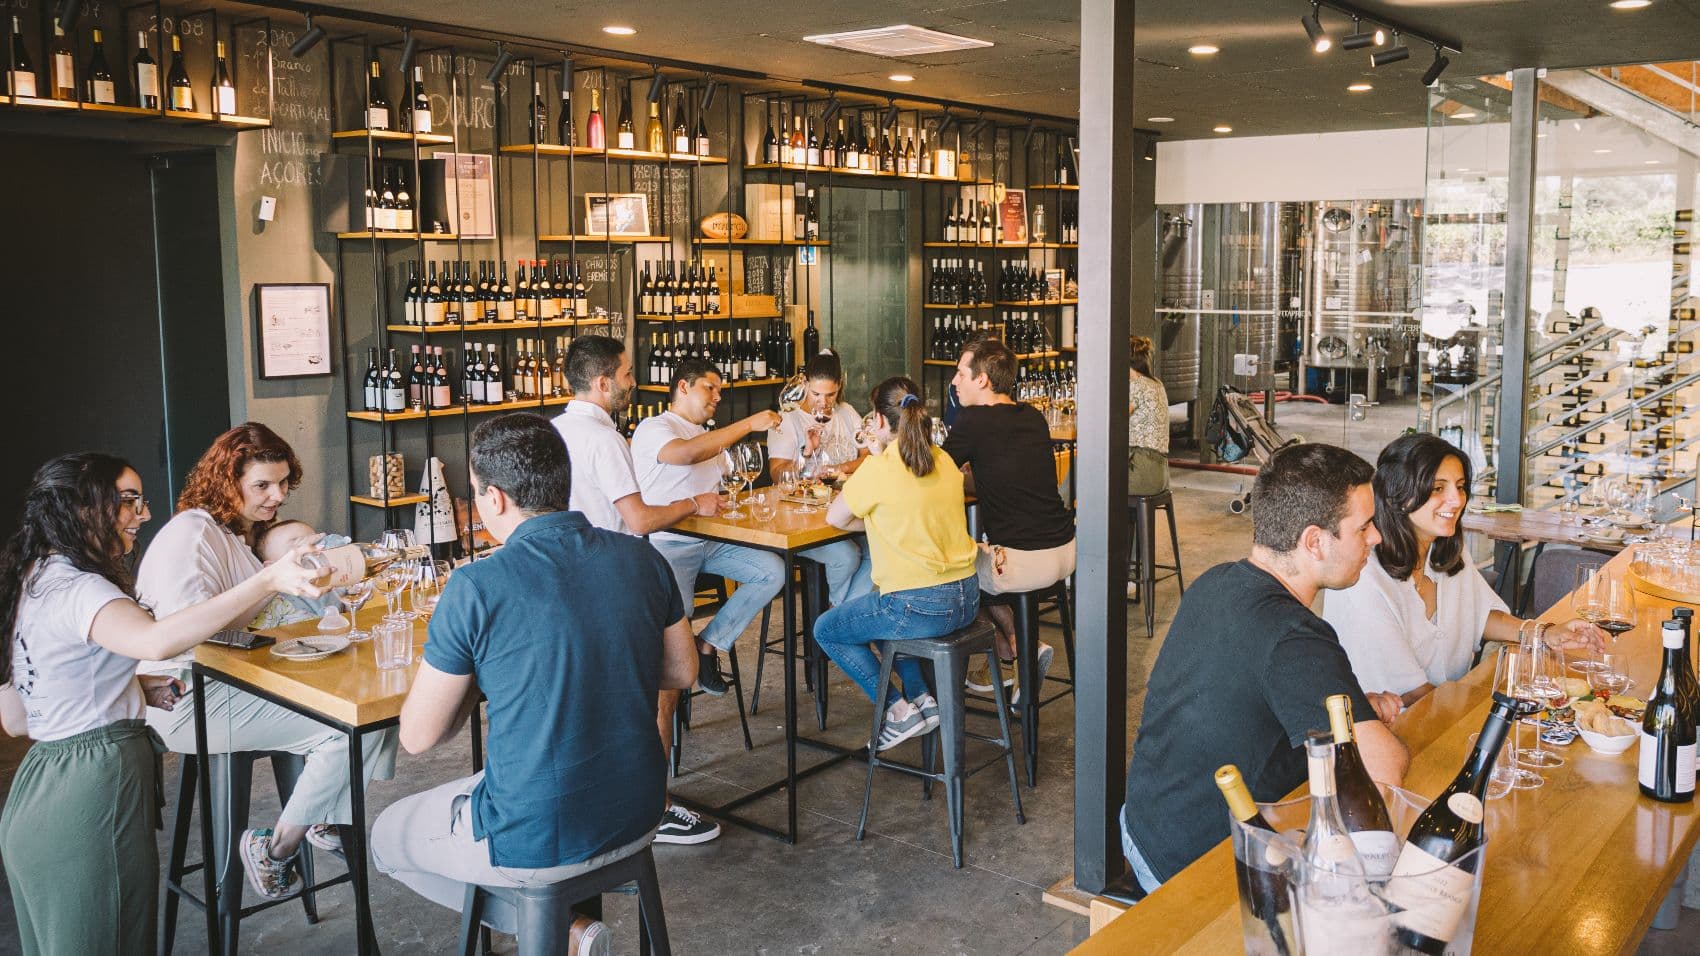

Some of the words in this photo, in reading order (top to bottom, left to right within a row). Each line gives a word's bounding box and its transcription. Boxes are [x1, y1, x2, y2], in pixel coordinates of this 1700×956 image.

[149, 15, 204, 36] 2008
[273, 102, 330, 124] PORTUGAL
[428, 93, 496, 129] DOURO
